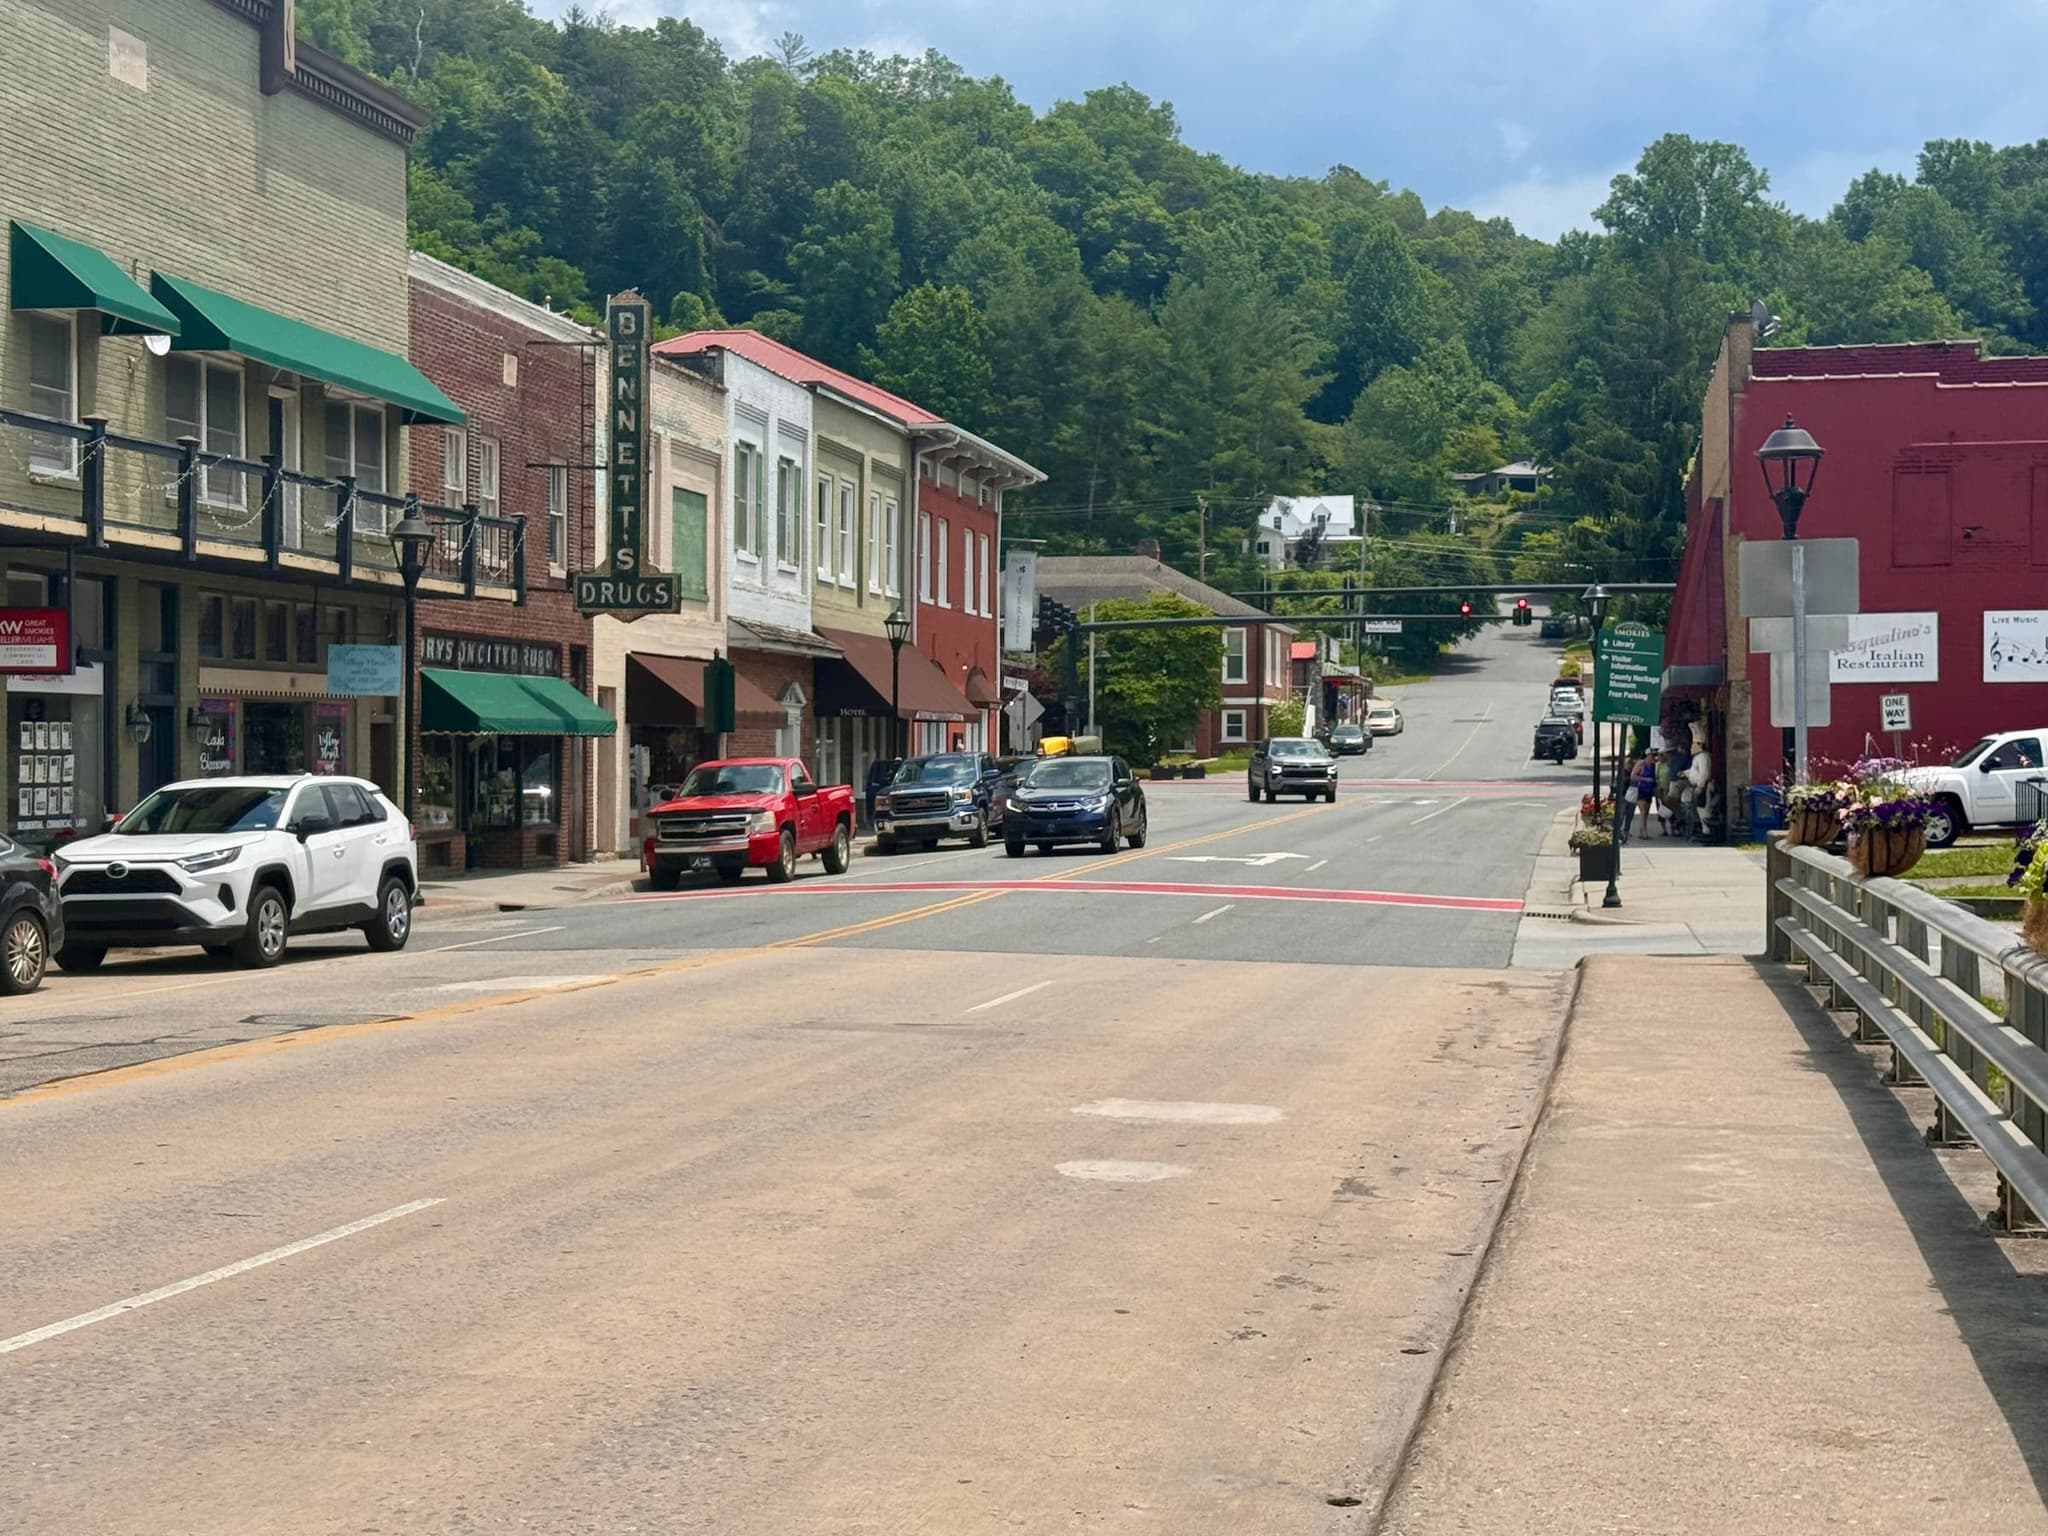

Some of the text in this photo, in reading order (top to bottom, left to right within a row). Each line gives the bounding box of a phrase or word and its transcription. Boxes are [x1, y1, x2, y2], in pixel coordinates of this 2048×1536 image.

[616, 312, 636, 570] BENNETT'S
[581, 581, 669, 604] DRUGS
[2013, 616, 2039, 624] MUSIC
[1612, 639, 1636, 649] Library
[1870, 649, 1924, 660] Italian
[1611, 662, 1648, 672] Information
[1837, 658, 1926, 670] Restaurant
[1609, 673, 1660, 684] County Heritage
[1609, 680, 1637, 689] Museum
[1608, 690, 1648, 701] Free Parking
[1885, 698, 1905, 707] ONE
[1886, 709, 1906, 718] WAY
